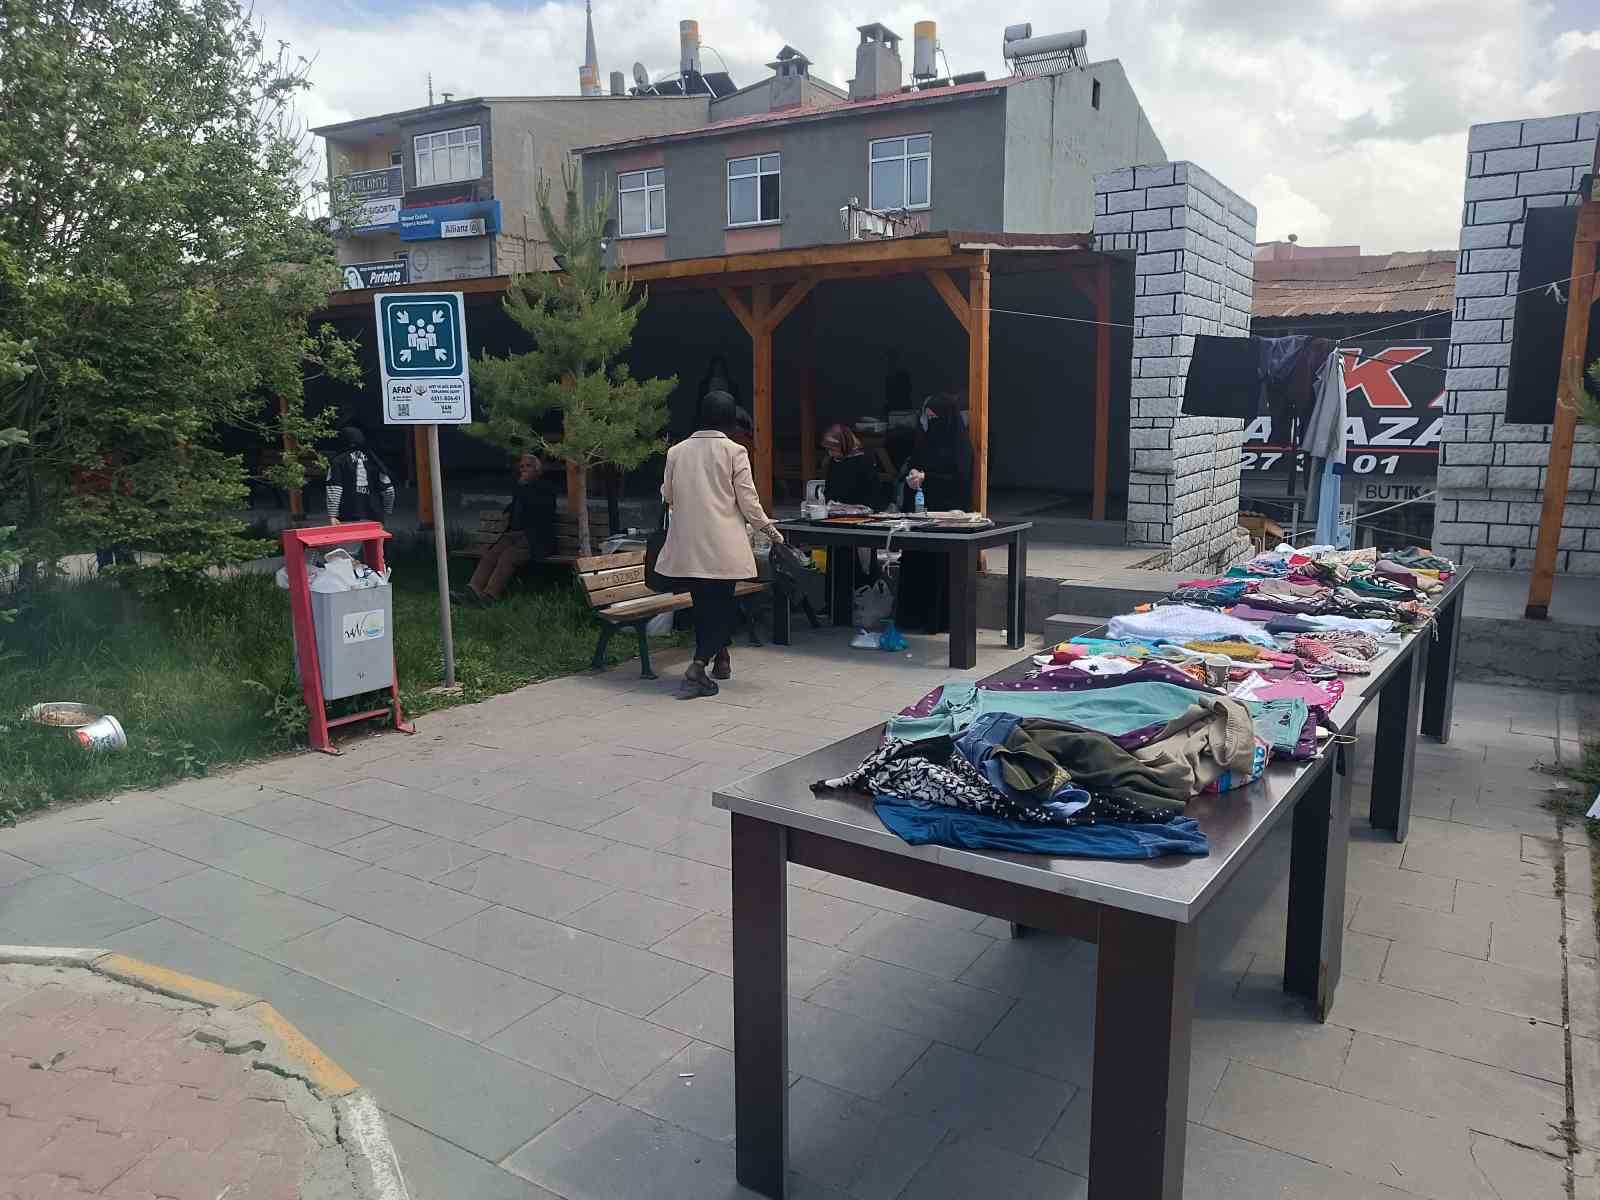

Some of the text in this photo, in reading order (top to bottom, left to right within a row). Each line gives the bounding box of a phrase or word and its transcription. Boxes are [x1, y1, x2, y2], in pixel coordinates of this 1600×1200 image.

[445, 223, 468, 233] Allianz
[1339, 346, 1446, 409] K
[392, 386, 412, 394] AFAD
[1352, 454, 1400, 474] 01
